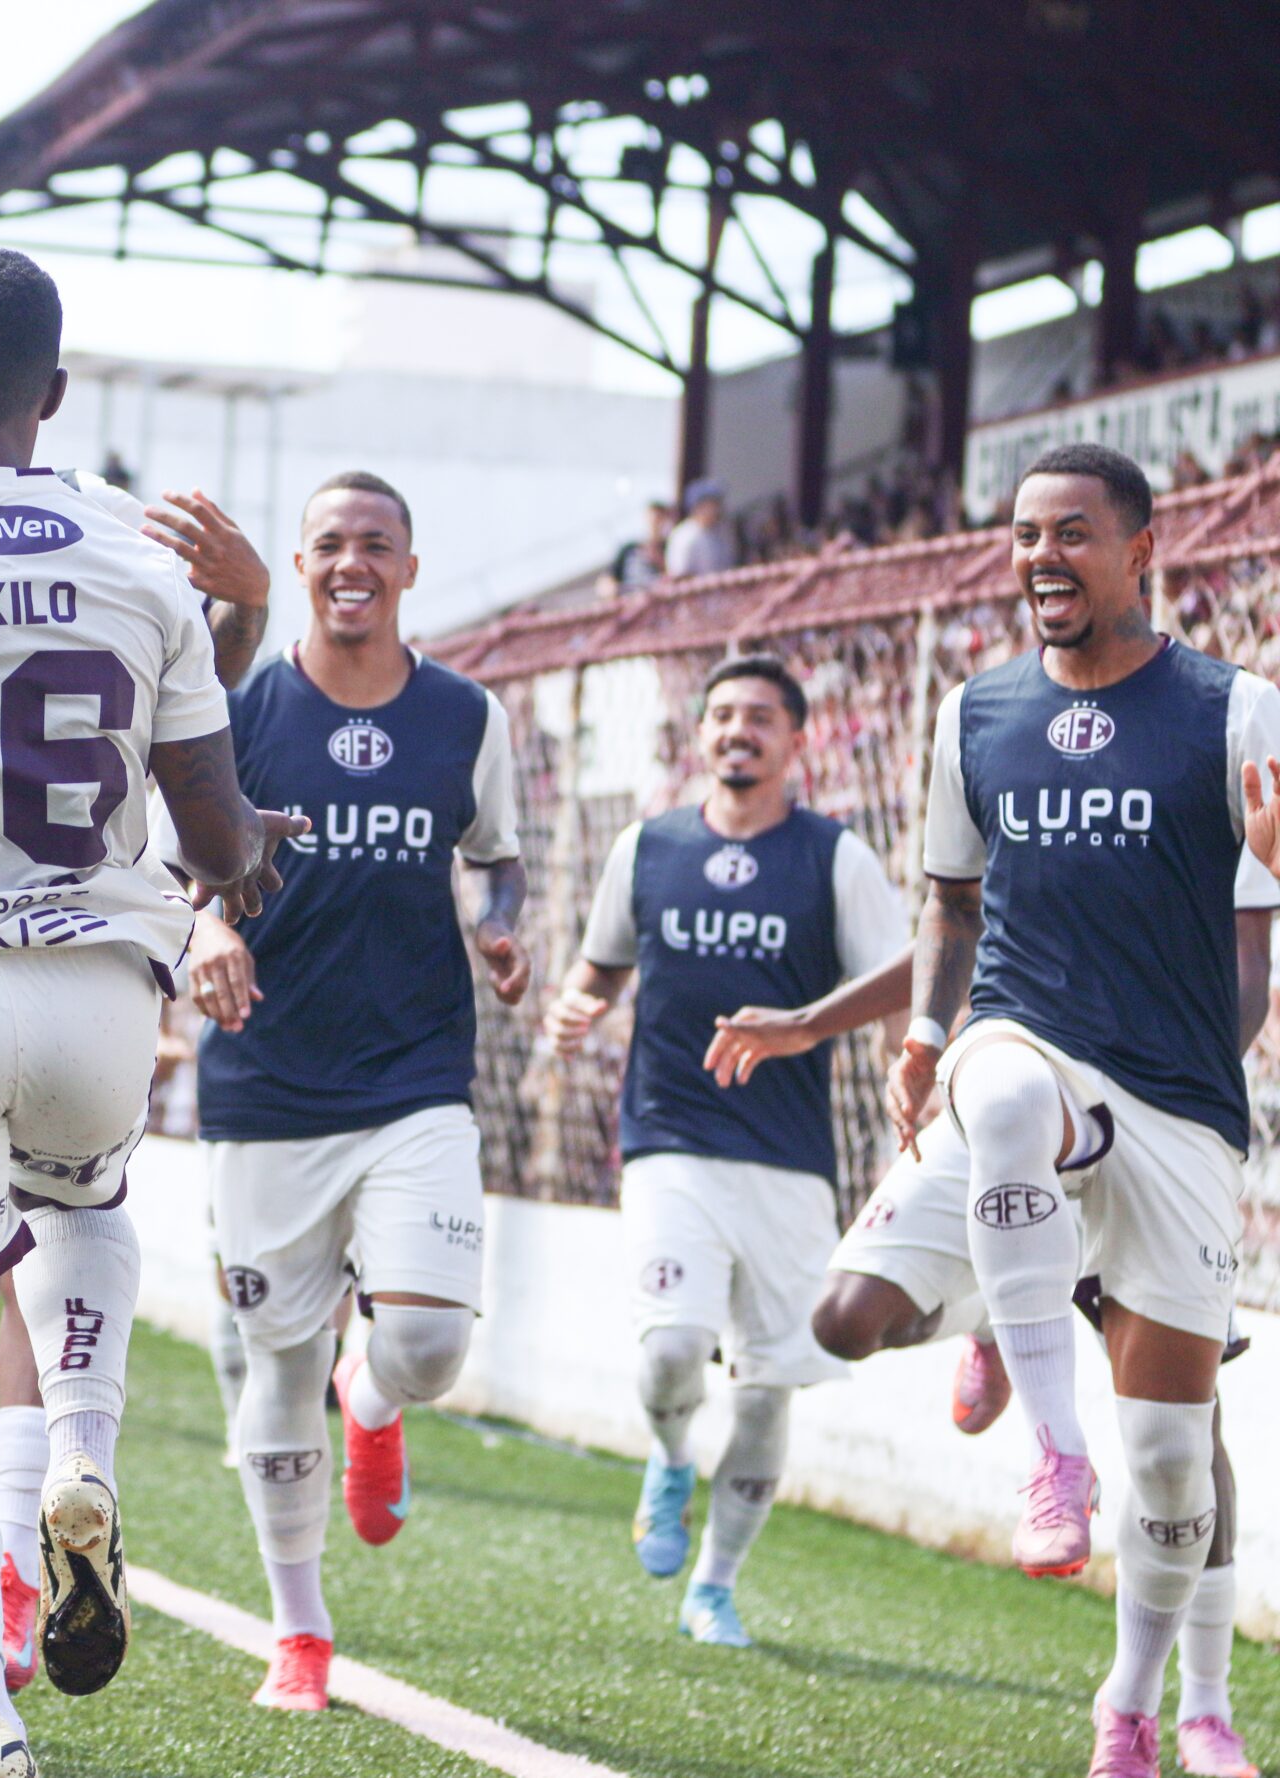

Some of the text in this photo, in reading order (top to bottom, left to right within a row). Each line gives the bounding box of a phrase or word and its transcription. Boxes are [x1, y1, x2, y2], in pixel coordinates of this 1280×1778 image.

[333, 729, 386, 765] AFE
[1051, 712, 1107, 749] AFE
[283, 804, 433, 854] LUPO
[998, 788, 1153, 841] LUPO
[327, 847, 428, 864] SPORT
[1040, 832, 1150, 848] SPORT
[661, 908, 787, 950] LUPO
[981, 1190, 1044, 1224] AFE
[60, 1297, 105, 1371] LUPO
